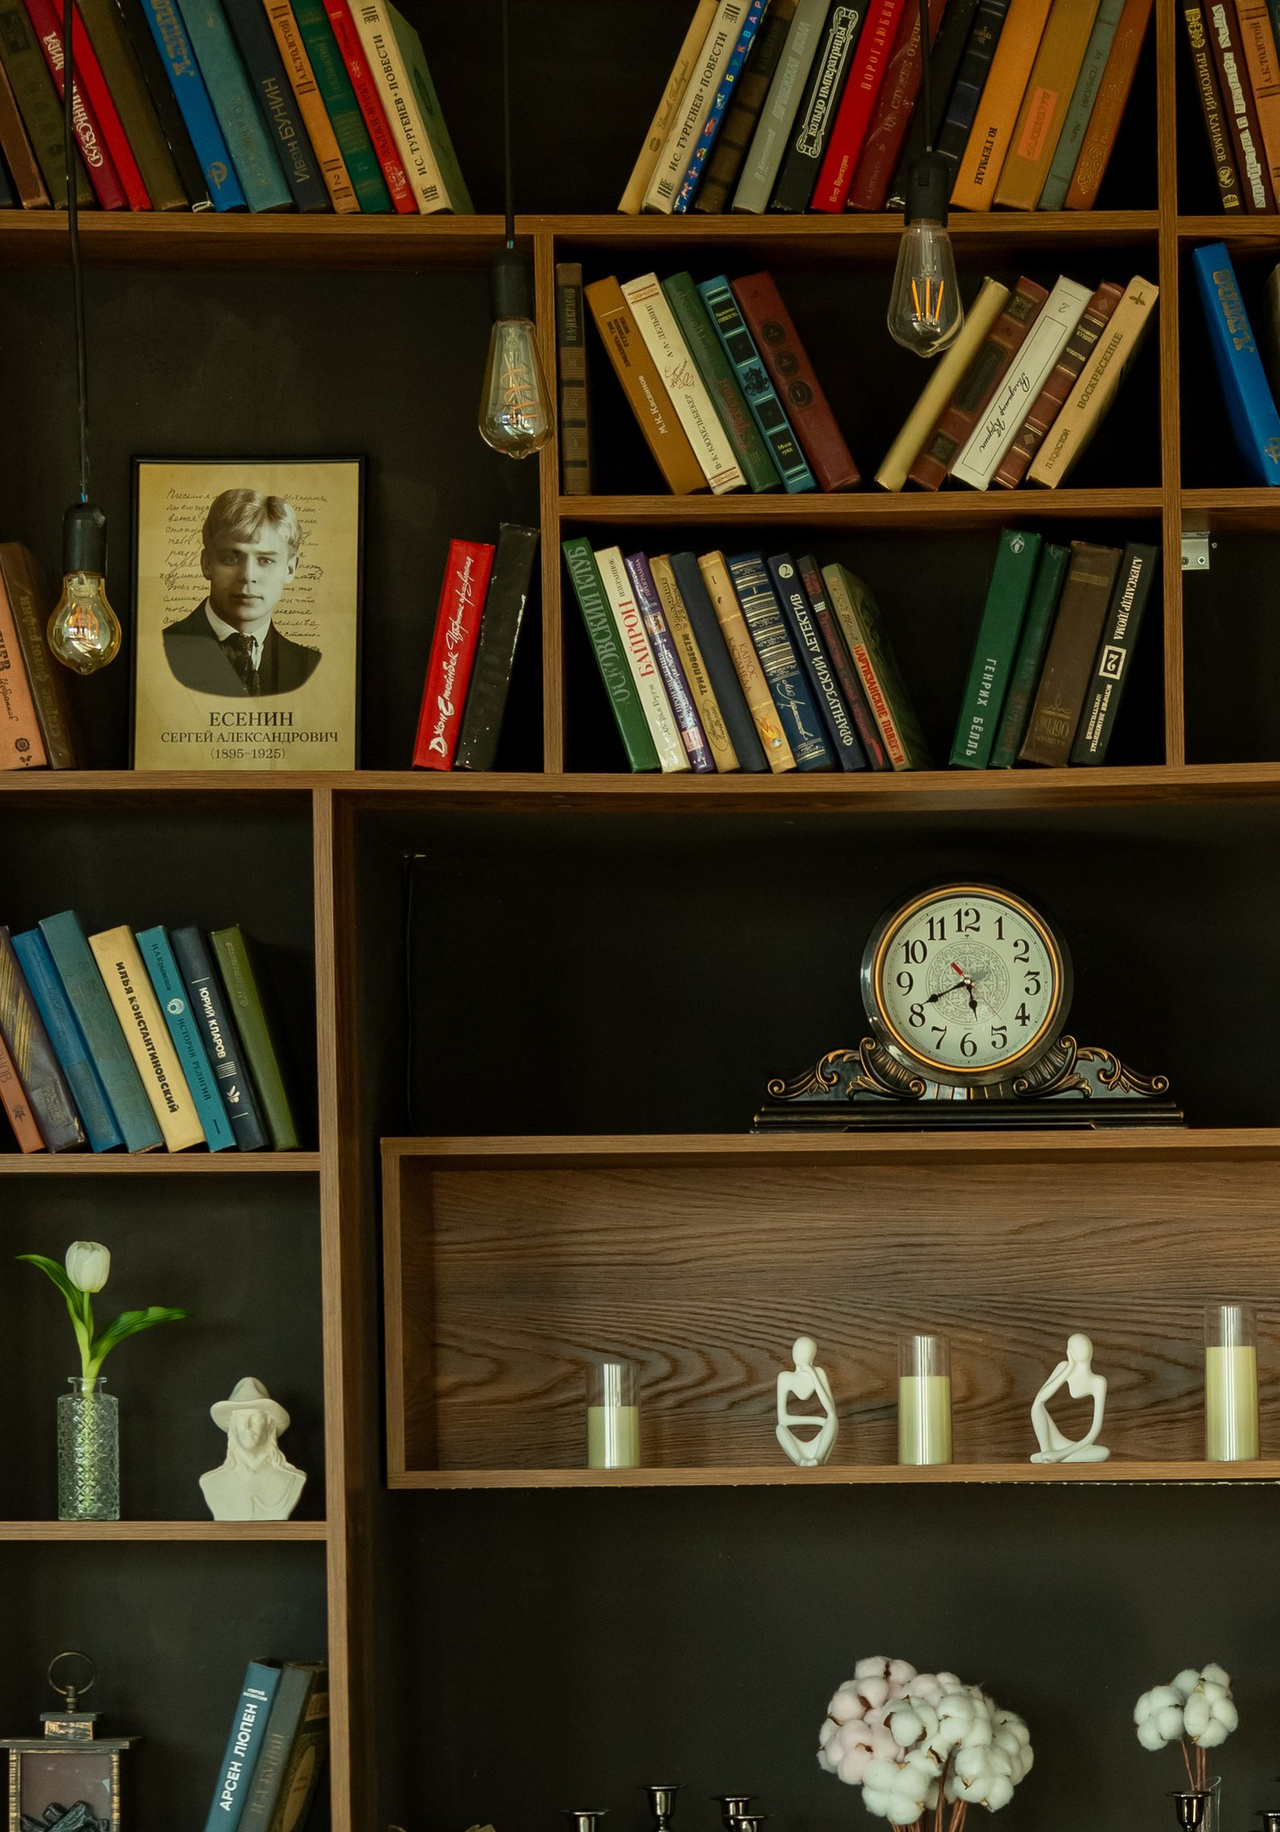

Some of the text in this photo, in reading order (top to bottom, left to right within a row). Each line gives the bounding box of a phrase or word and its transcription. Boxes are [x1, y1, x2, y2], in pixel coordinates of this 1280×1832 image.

[859, 0, 895, 90] ПОРОГ ЛЮБВИ
[883, 59, 913, 132] НА СЛУЖБЕ
[1195, 52, 1226, 161] ГРИГОРИЙ КЛИМОВ
[259, 75, 311, 183] Иван БУНИН
[1076, 329, 1124, 411] ВОСКРЕСЕНИЕ
[636, 373, 659, 414] Касвинов
[973, 369, 1034, 457] Владимир Крупин
[1111, 555, 1143, 641] АЛЕКСАНДР ДЮМА
[606, 557, 656, 678] БАЙРОН ИЗБРАННОЕ
[787, 592, 821, 654] ДЕТЕКТИВ
[727, 636, 753, 694] КАСТАНЕДА
[738, 643, 759, 680] КАРЛОС
[1106, 653, 1119, 672] 2
[209, 711, 294, 727] ЕСЕНИН
[808, 654, 857, 748] ФРАНЦУЗСКИЙ
[963, 657, 997, 757] ГЕНРИХ БЁЛЛЬ
[160, 730, 338, 745] СЕРГЕЙ АЛЕКСАНДРОВИЧ
[210, 748, 286, 760] (1895–1925)
[925, 916, 947, 941] 11
[953, 908, 980, 933] 12
[994, 915, 1005, 941] 1
[900, 939, 927, 964] 10
[1013, 938, 1029, 963] 2
[896, 971, 914, 996] 9
[1023, 970, 1041, 996] 3
[198, 987, 226, 1059] ЮРИЙ КЛАРОВ
[909, 1003, 925, 1027] 8
[1014, 1002, 1030, 1026] 4
[114, 960, 180, 1114] ИЛЬЯ КОНСТАНТИНОВСКИЙ
[176, 1017, 197, 1058] ИСТОРИЯ
[931, 1025, 947, 1050] 7
[960, 1032, 977, 1057] 6
[991, 1025, 1008, 1049] 5
